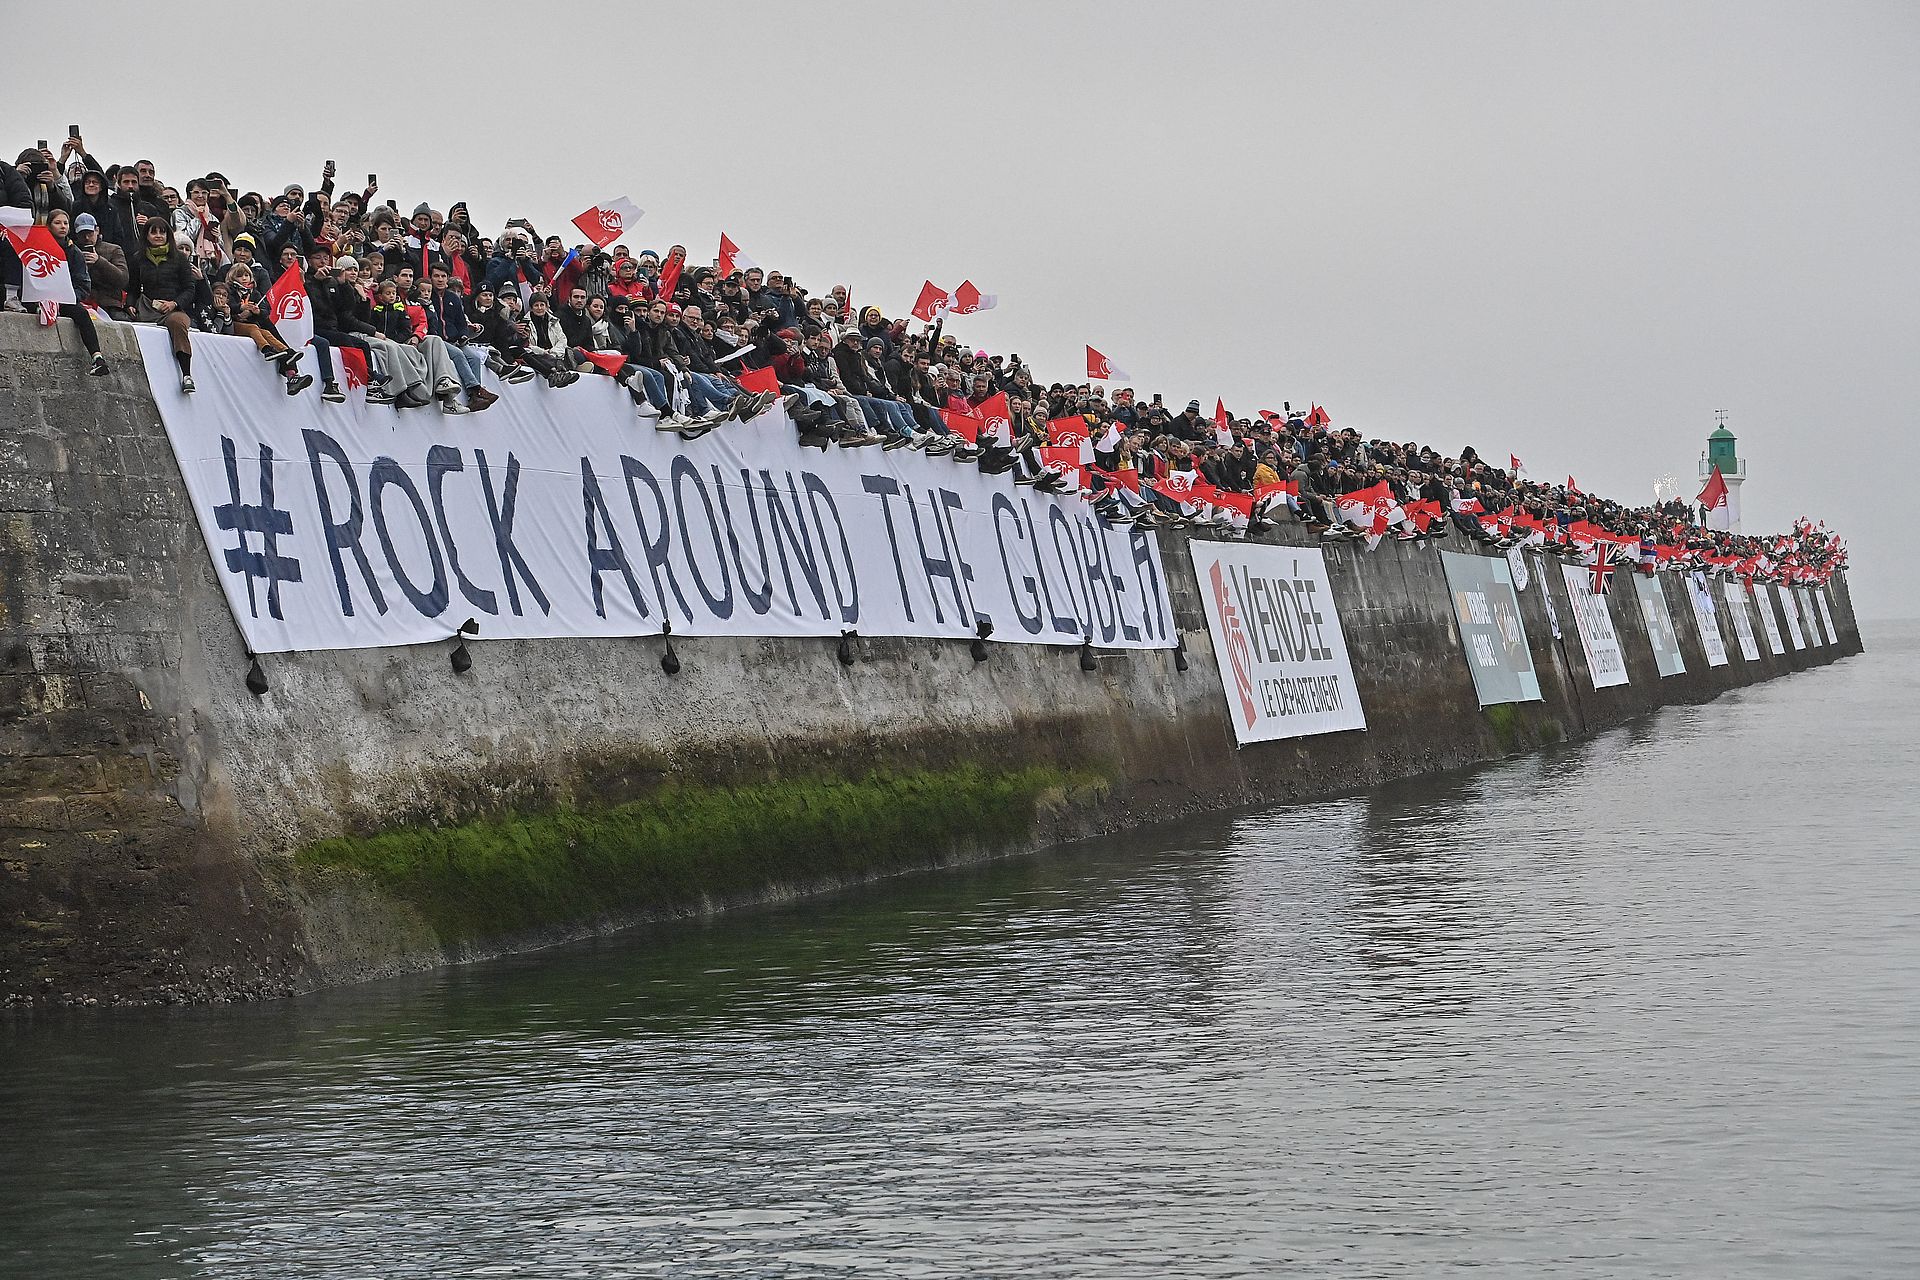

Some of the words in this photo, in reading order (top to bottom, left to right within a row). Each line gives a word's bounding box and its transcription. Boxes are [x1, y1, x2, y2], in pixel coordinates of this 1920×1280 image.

[213, 428, 550, 620] #ROCK
[581, 454, 859, 625] AROUND
[861, 474, 991, 629] THE
[1229, 560, 1332, 663] VENDÉE
[1258, 679, 1277, 718] LE
[1273, 670, 1344, 716] DÉPARTEMENT
